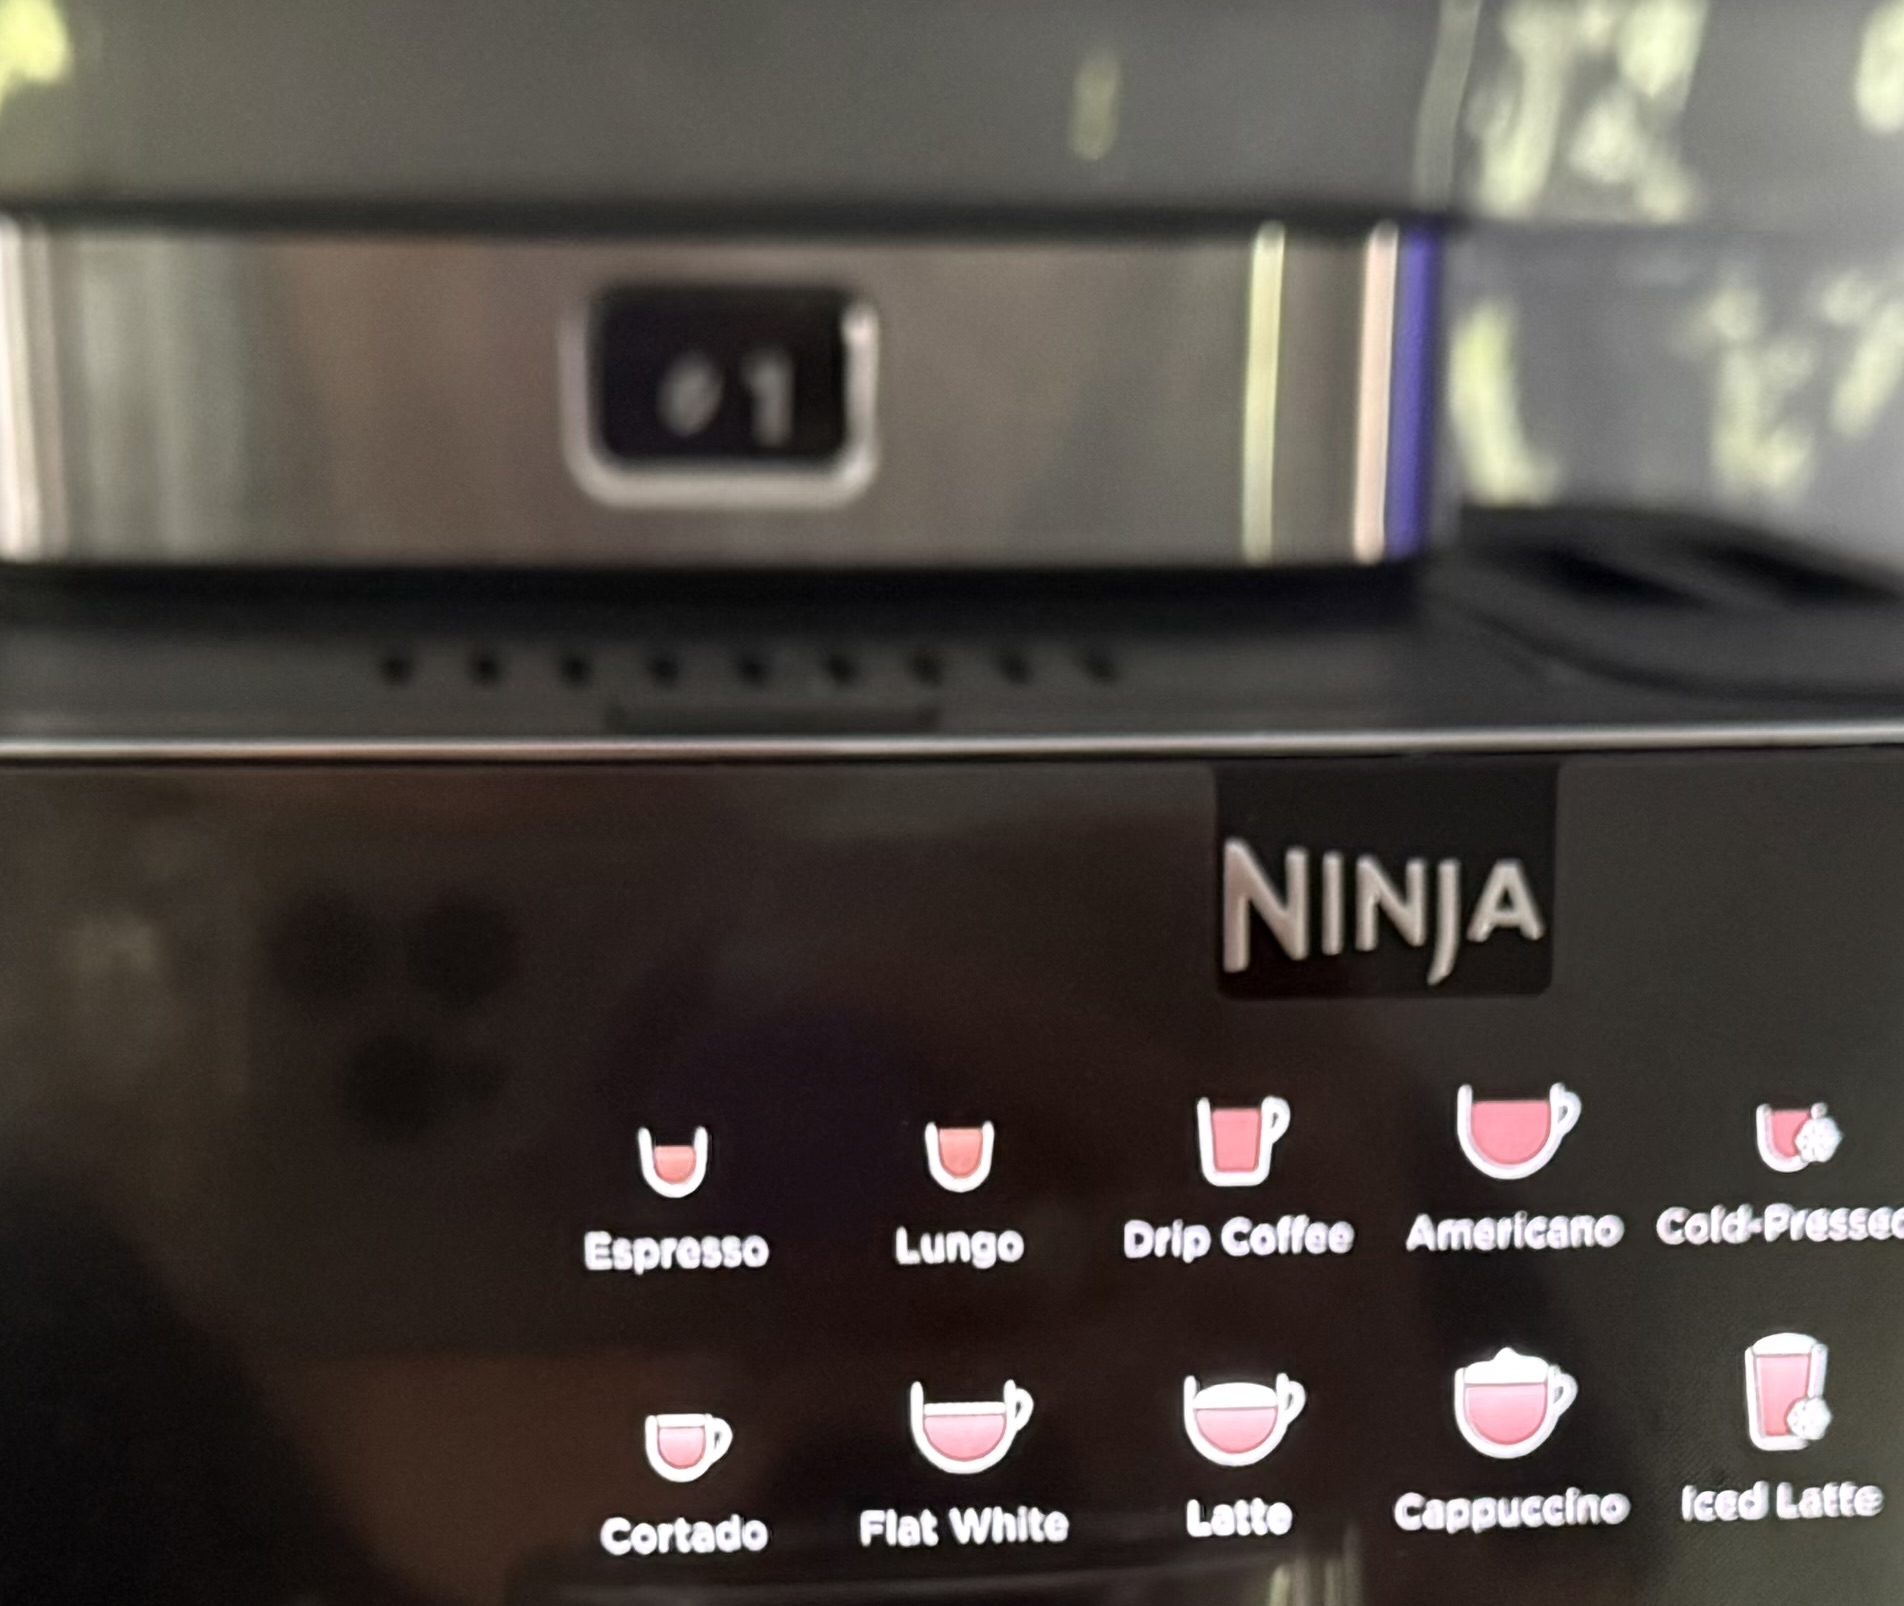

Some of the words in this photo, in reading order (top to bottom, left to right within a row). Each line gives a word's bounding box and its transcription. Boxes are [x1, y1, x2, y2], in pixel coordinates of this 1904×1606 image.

[1224, 838, 1543, 985] NINJA
[895, 1226, 1025, 1270] Lungo
[1123, 1219, 1211, 1265] Drip
[1219, 1214, 1355, 1257] Coffee
[1405, 1210, 1625, 1252] Americano
[583, 1230, 770, 1276] Espresso
[1186, 1497, 1293, 1538] Latte
[1392, 1486, 1632, 1534] Cappuccino
[1681, 1480, 1769, 1522] Iced
[1775, 1481, 1884, 1520] Latte
[599, 1513, 769, 1556] Cortado
[859, 1508, 939, 1547] Flat
[948, 1505, 1070, 1545] White
